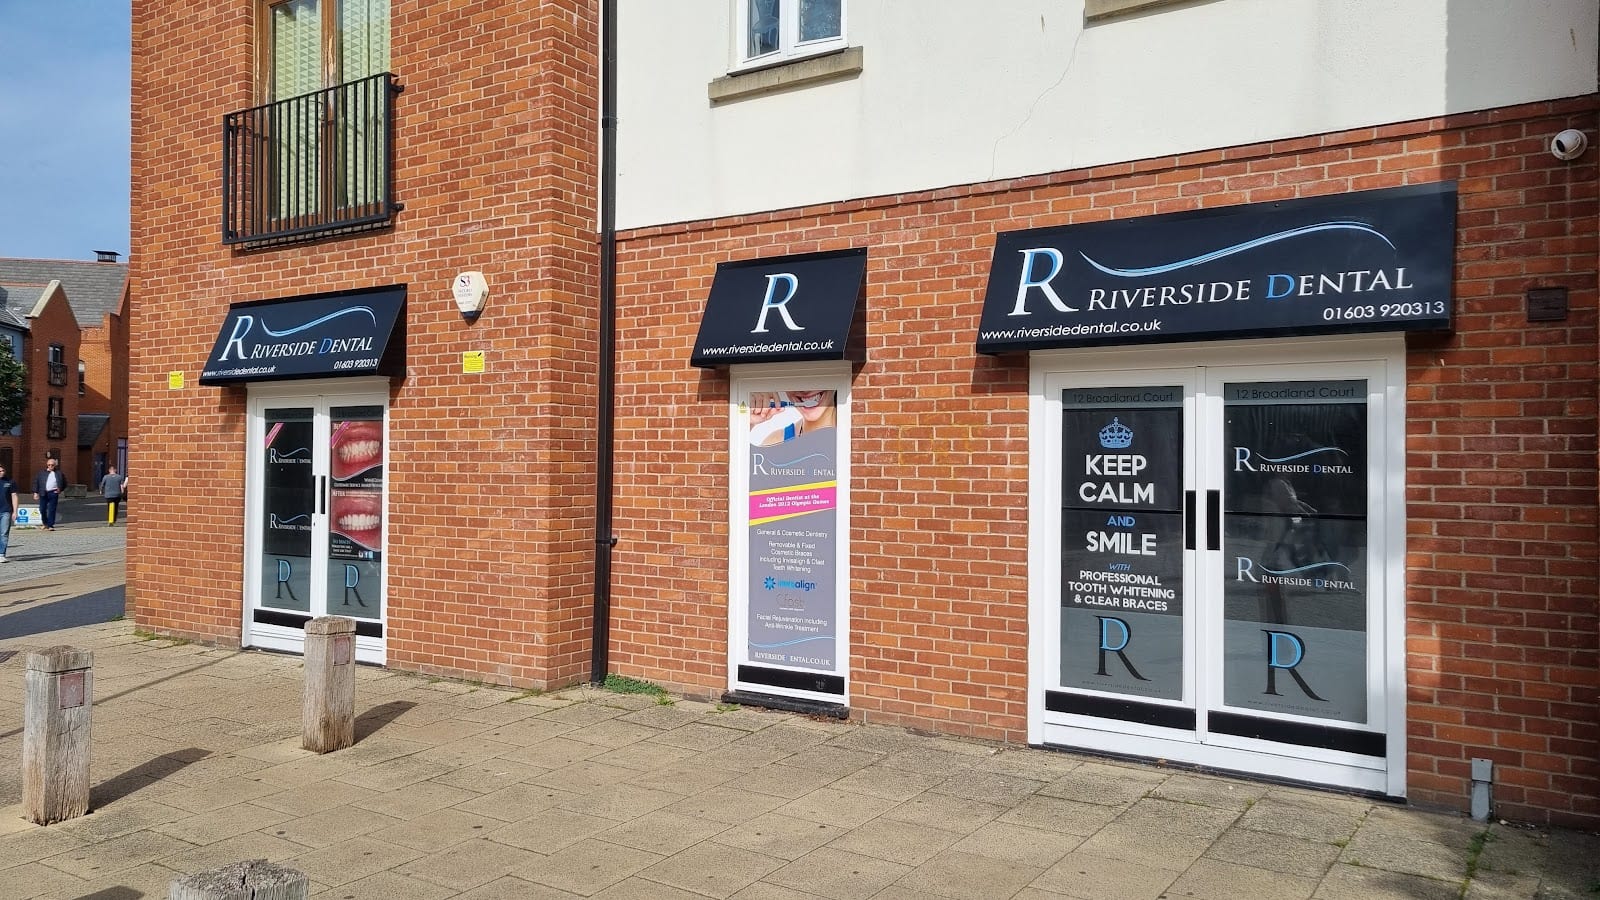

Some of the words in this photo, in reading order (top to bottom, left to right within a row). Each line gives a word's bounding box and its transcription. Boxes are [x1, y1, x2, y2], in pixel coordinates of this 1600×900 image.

[1007, 247, 1080, 317] R
[1086, 278, 1251, 312] RIVERSIDE
[1266, 267, 1413, 299] DENTAL
[750, 273, 805, 333] R
[1322, 303, 1376, 321] 01603
[1379, 300, 1445, 319] 920313
[218, 315, 254, 361] R
[980, 319, 1162, 341] www.riversidedental.co.uk
[251, 341, 317, 359] RIVERSIDE
[318, 336, 374, 354] DENTAL
[702, 339, 834, 356] www.riversidedental.co.uk
[202, 365, 277, 377] www.riversidedental.co.uk
[333, 360, 354, 370] 01603
[354, 358, 379, 369] 920313
[1073, 394, 1084, 403] 12
[1086, 392, 1139, 403] Broadland
[1143, 392, 1173, 402] Court
[1236, 389, 1248, 399] 12
[1252, 387, 1315, 399] Broadland
[1319, 387, 1355, 397] Court
[752, 453, 770, 476] R
[1085, 454, 1147, 476] KEEP
[1233, 446, 1258, 472] R
[770, 467, 806, 476] RIVERSIDE
[1260, 463, 1310, 473] RIVERSIDE
[1313, 464, 1353, 474] DENTAL
[1079, 482, 1155, 504] CALM
[1107, 515, 1136, 527] AND
[805, 531, 828, 539] Dentistry
[1086, 531, 1157, 556] SMILE
[760, 556, 781, 564] Including
[782, 557, 806, 565] Invisalign
[1109, 563, 1131, 571] WITH
[786, 565, 811, 574] Whitening
[1079, 570, 1161, 586] PROFESSIONAL
[1235, 556, 1261, 583] R
[1068, 581, 1107, 594] TOOTH
[1110, 584, 1175, 600] WHITENING
[1262, 574, 1312, 587] RIVERSIDE
[1315, 578, 1356, 590] DENTAL
[1074, 594, 1082, 604] &
[1084, 595, 1120, 607] CLEAR
[1122, 598, 1168, 611] BRACES
[772, 615, 804, 623] Rejuvenation
[794, 625, 819, 633] Treatment
